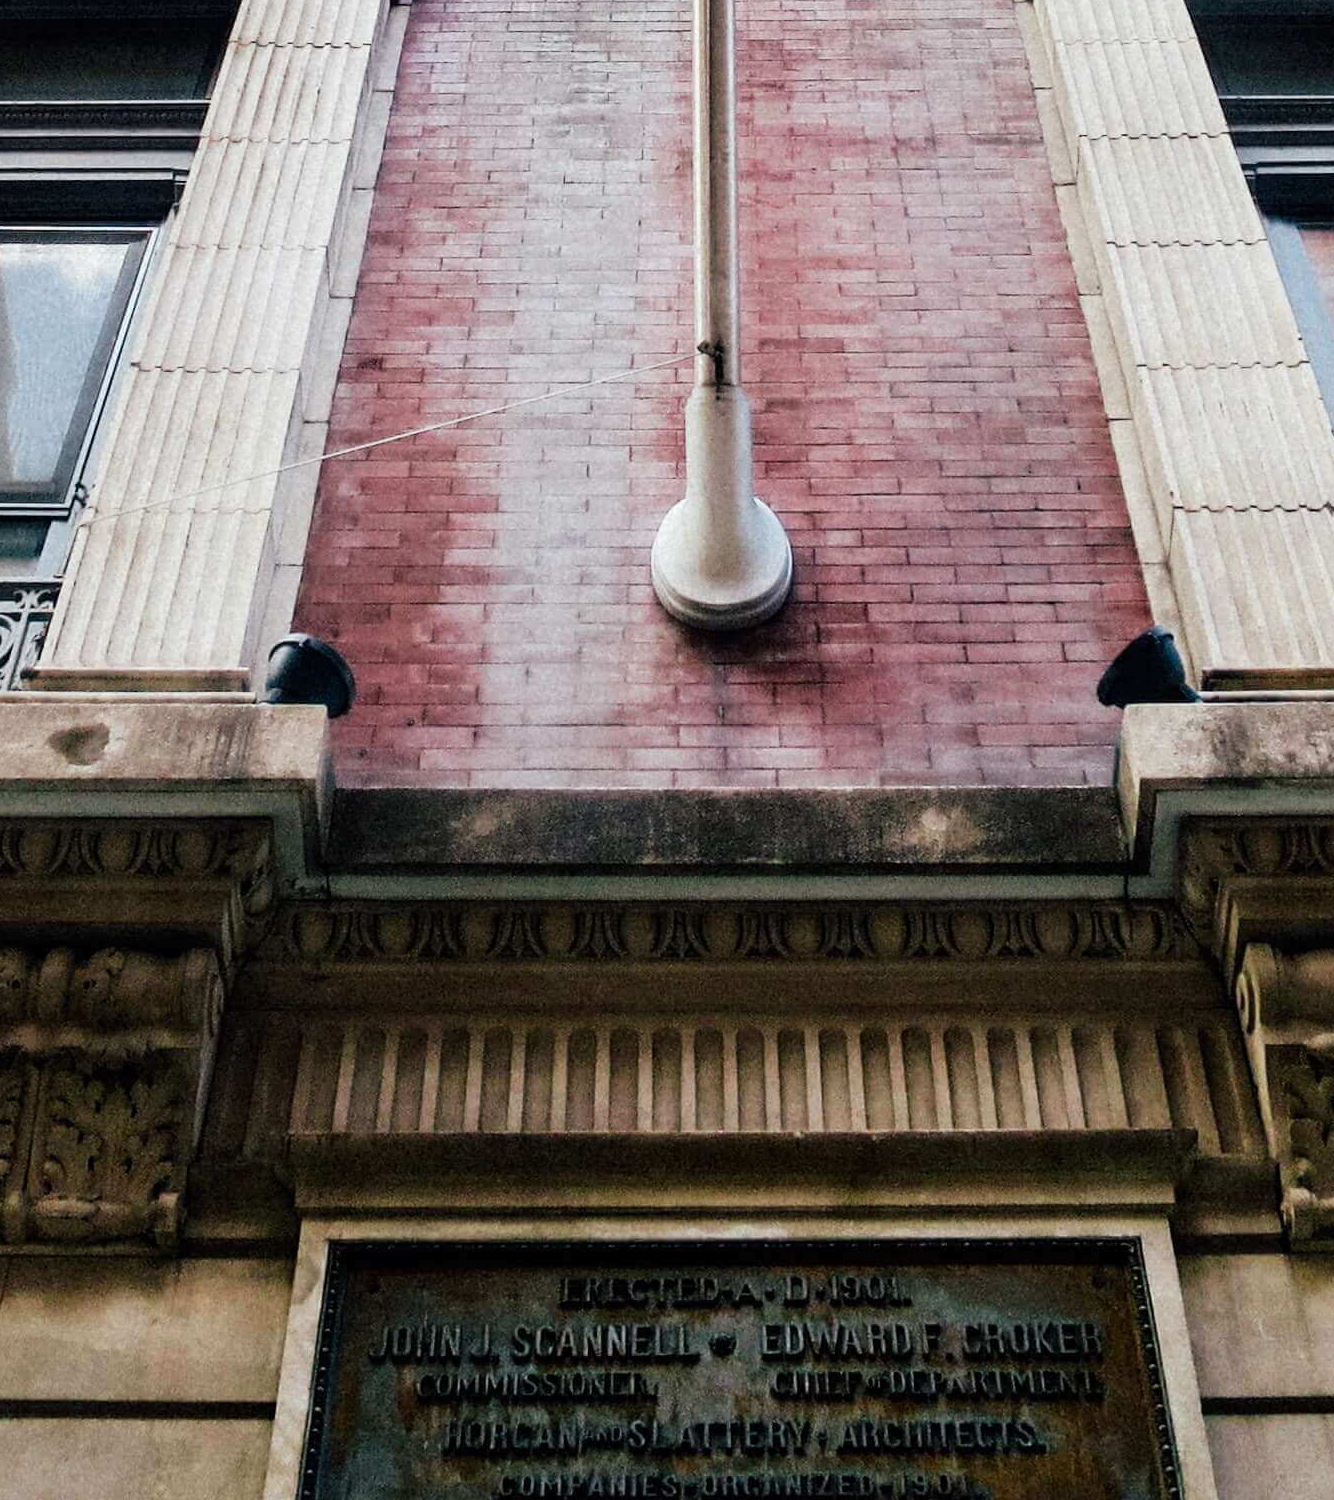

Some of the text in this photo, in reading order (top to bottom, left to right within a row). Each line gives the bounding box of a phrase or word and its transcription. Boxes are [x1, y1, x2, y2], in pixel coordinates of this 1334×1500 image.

[368, 1322, 463, 1361] JOHN
[512, 1322, 700, 1361] SCANNELL
[762, 1322, 914, 1360] EDWARD
[962, 1322, 1105, 1361] CROKER
